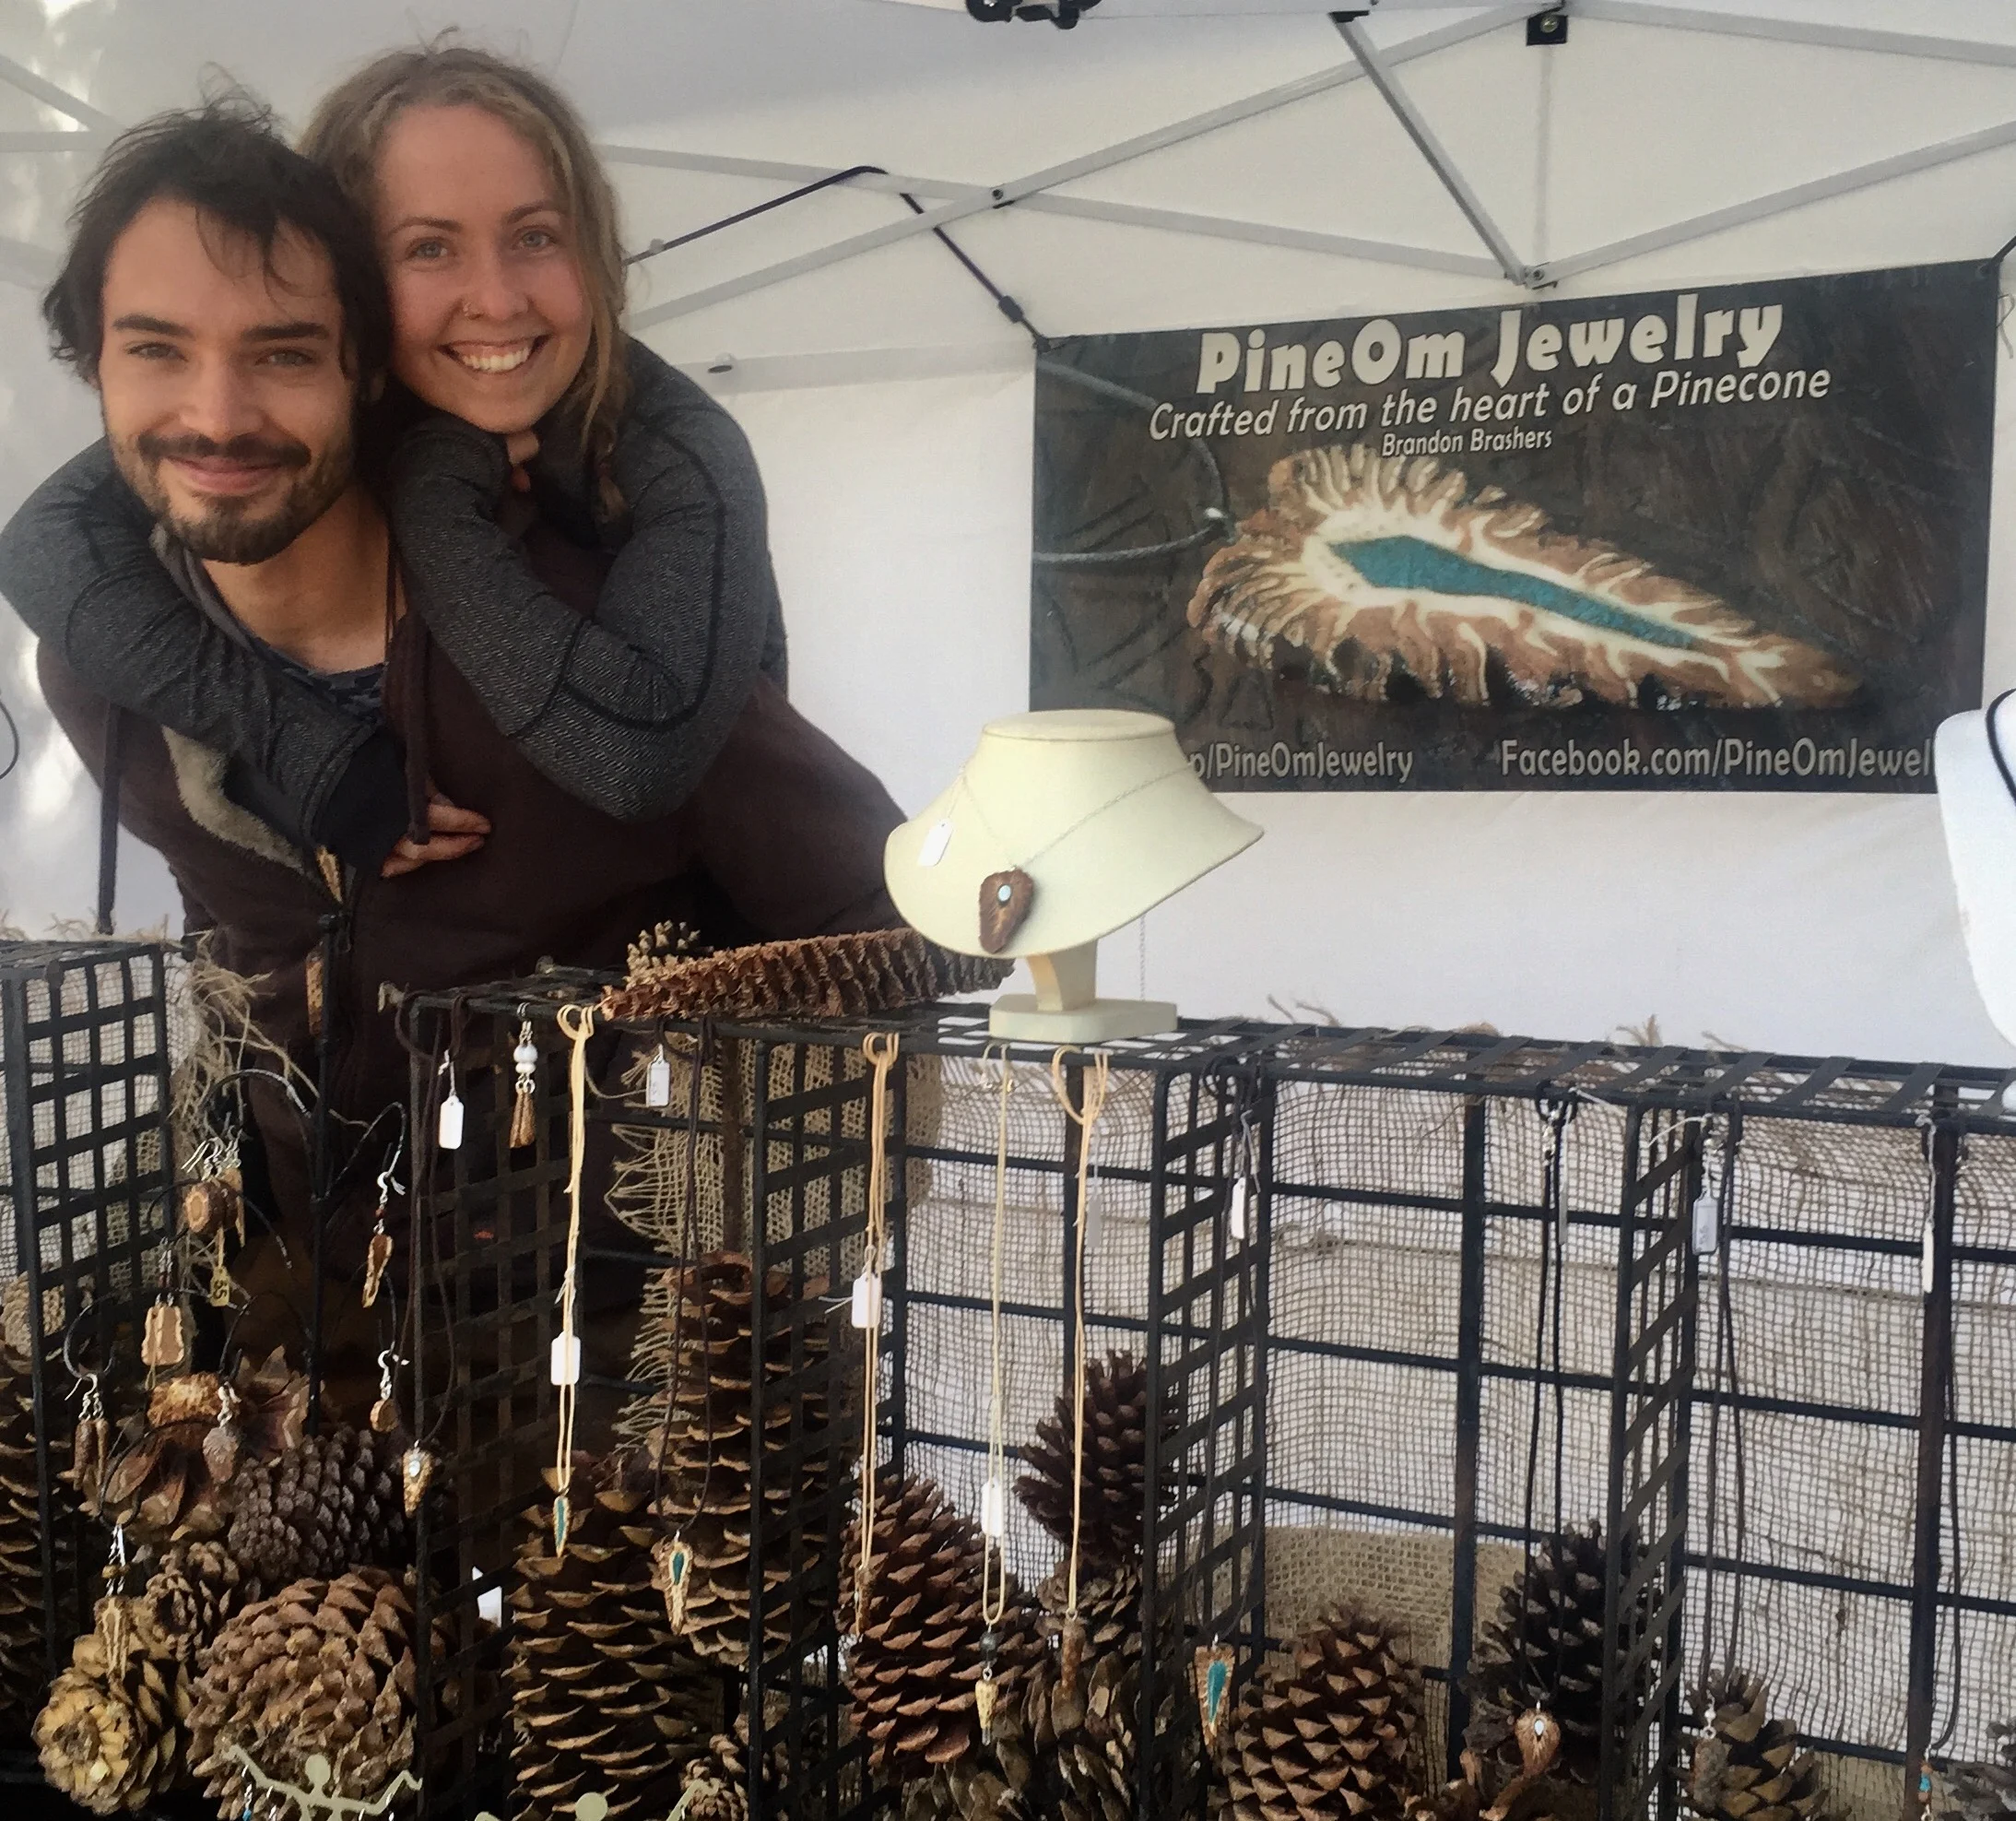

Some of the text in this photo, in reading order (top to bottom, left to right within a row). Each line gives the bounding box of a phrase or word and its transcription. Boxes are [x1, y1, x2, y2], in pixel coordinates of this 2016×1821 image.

[1196, 293, 1783, 394] PineOm Jewelry
[1149, 368, 1832, 441] Crafted from the heart of a Pinecone
[1383, 427, 1553, 457] Brandon Brashers
